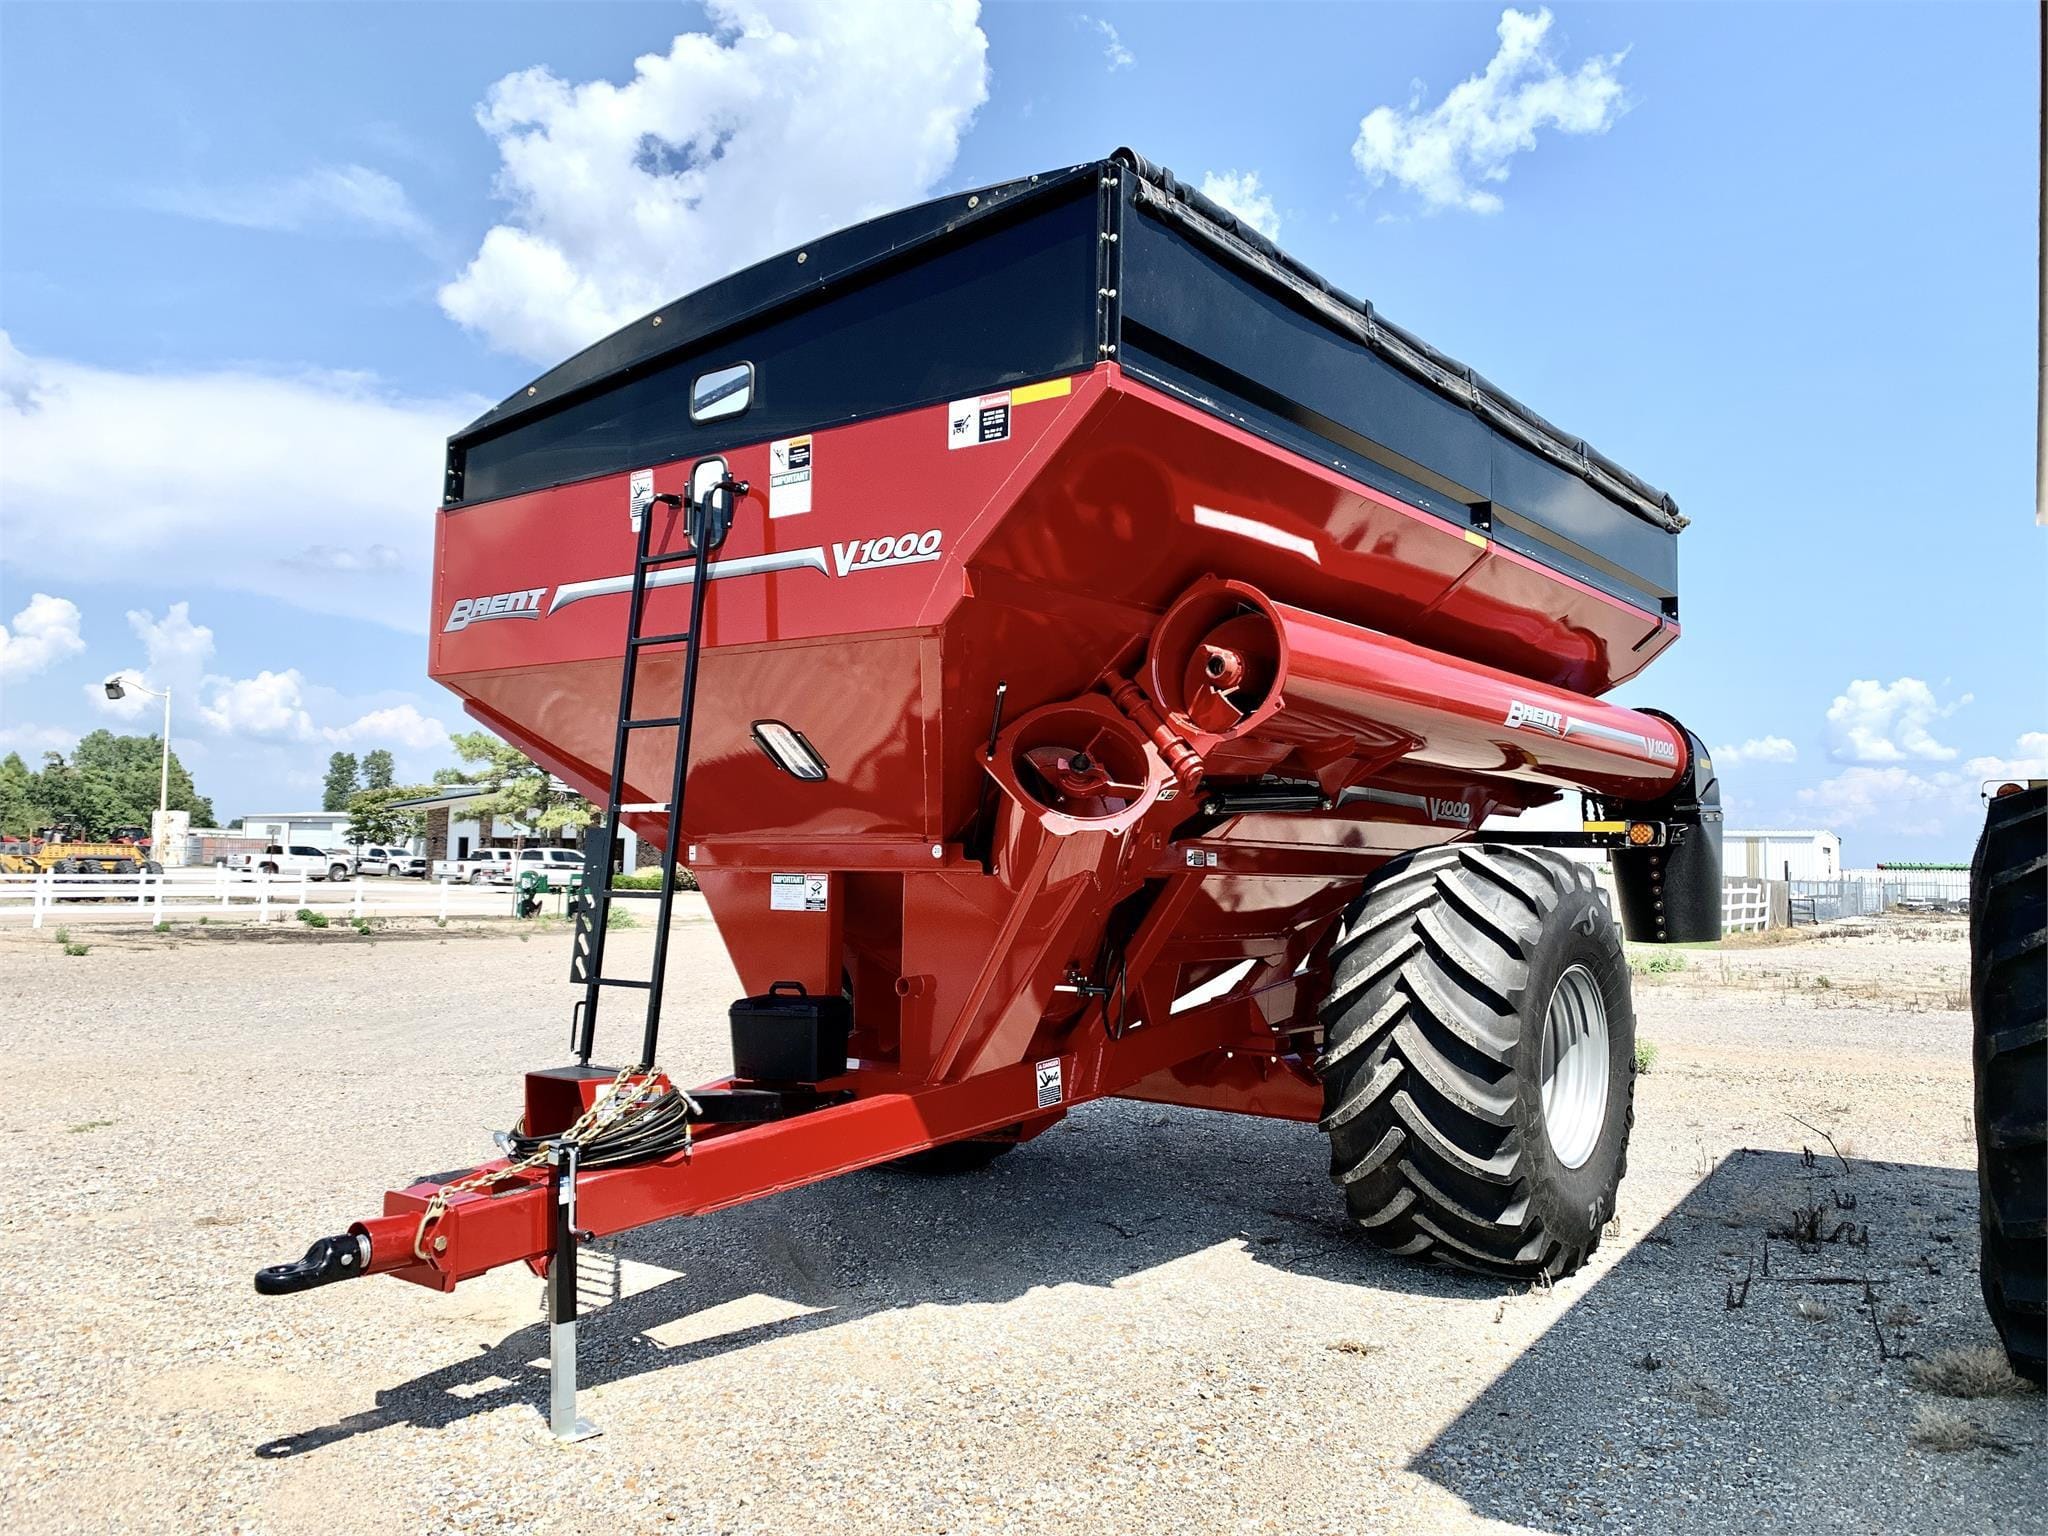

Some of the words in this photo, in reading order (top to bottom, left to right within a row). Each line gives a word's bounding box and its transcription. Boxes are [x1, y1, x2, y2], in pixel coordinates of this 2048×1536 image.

[832, 529, 942, 577] V1000
[443, 587, 548, 633] BRENT
[1504, 699, 1562, 729] BRENT
[1647, 737, 1674, 758] V1000
[1430, 797, 1470, 821] V1000
[774, 875, 804, 884] IMPORTANT
